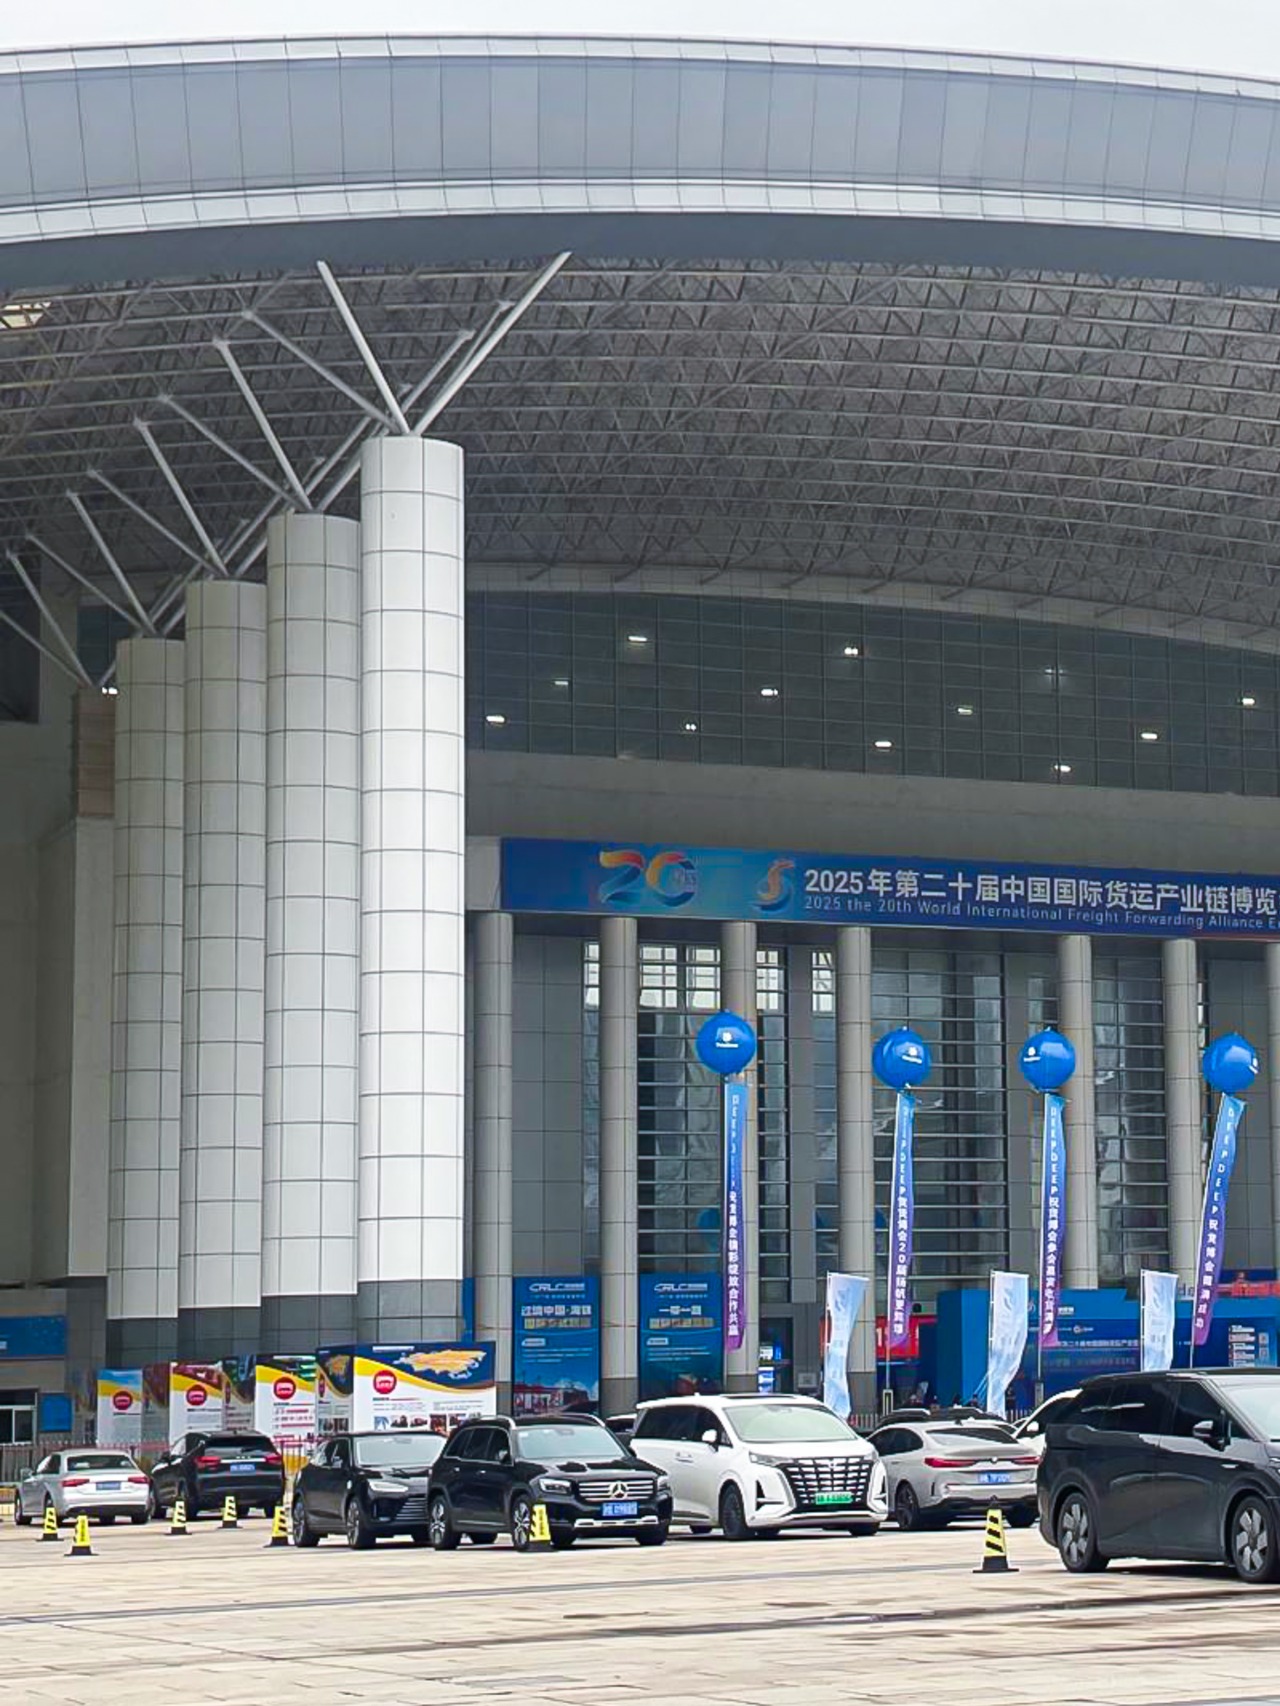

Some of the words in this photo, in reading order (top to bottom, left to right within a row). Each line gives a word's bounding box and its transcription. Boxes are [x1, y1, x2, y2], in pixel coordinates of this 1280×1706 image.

[804, 895, 841, 910] 2025
[847, 897, 872, 912] the
[878, 899, 912, 914] 20th
[918, 901, 961, 916] World
[967, 903, 1062, 921] International
[1068, 908, 1119, 925] Freight
[1124, 911, 1204, 929] Forwarding
[1208, 914, 1263, 929] Alliance
